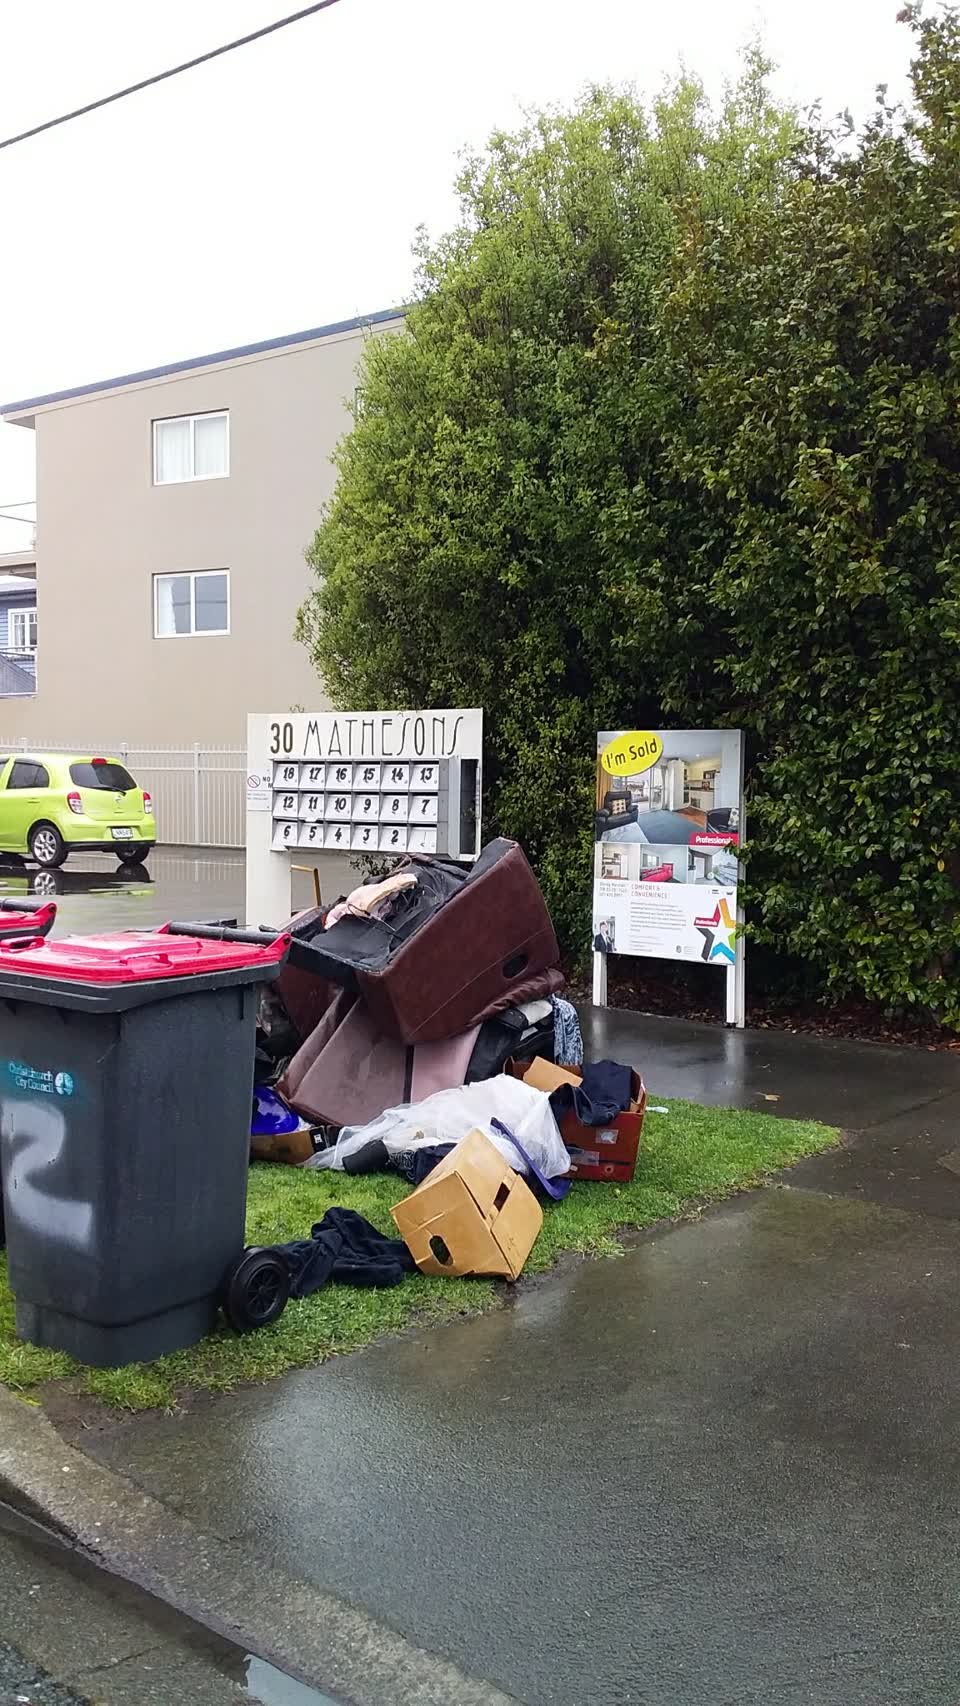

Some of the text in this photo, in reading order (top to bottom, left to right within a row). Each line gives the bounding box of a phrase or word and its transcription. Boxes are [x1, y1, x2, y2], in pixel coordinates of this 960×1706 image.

[270, 716, 464, 756] 30 MATHESONS
[606, 738, 658, 768] I'm Sold
[283, 767, 433, 781] 18 17 16 15 14 13
[283, 796, 430, 813] 12 11 10 9 8 7
[283, 825, 399, 843] 6 5 4 3 2
[1, 1100, 94, 1248] 2
